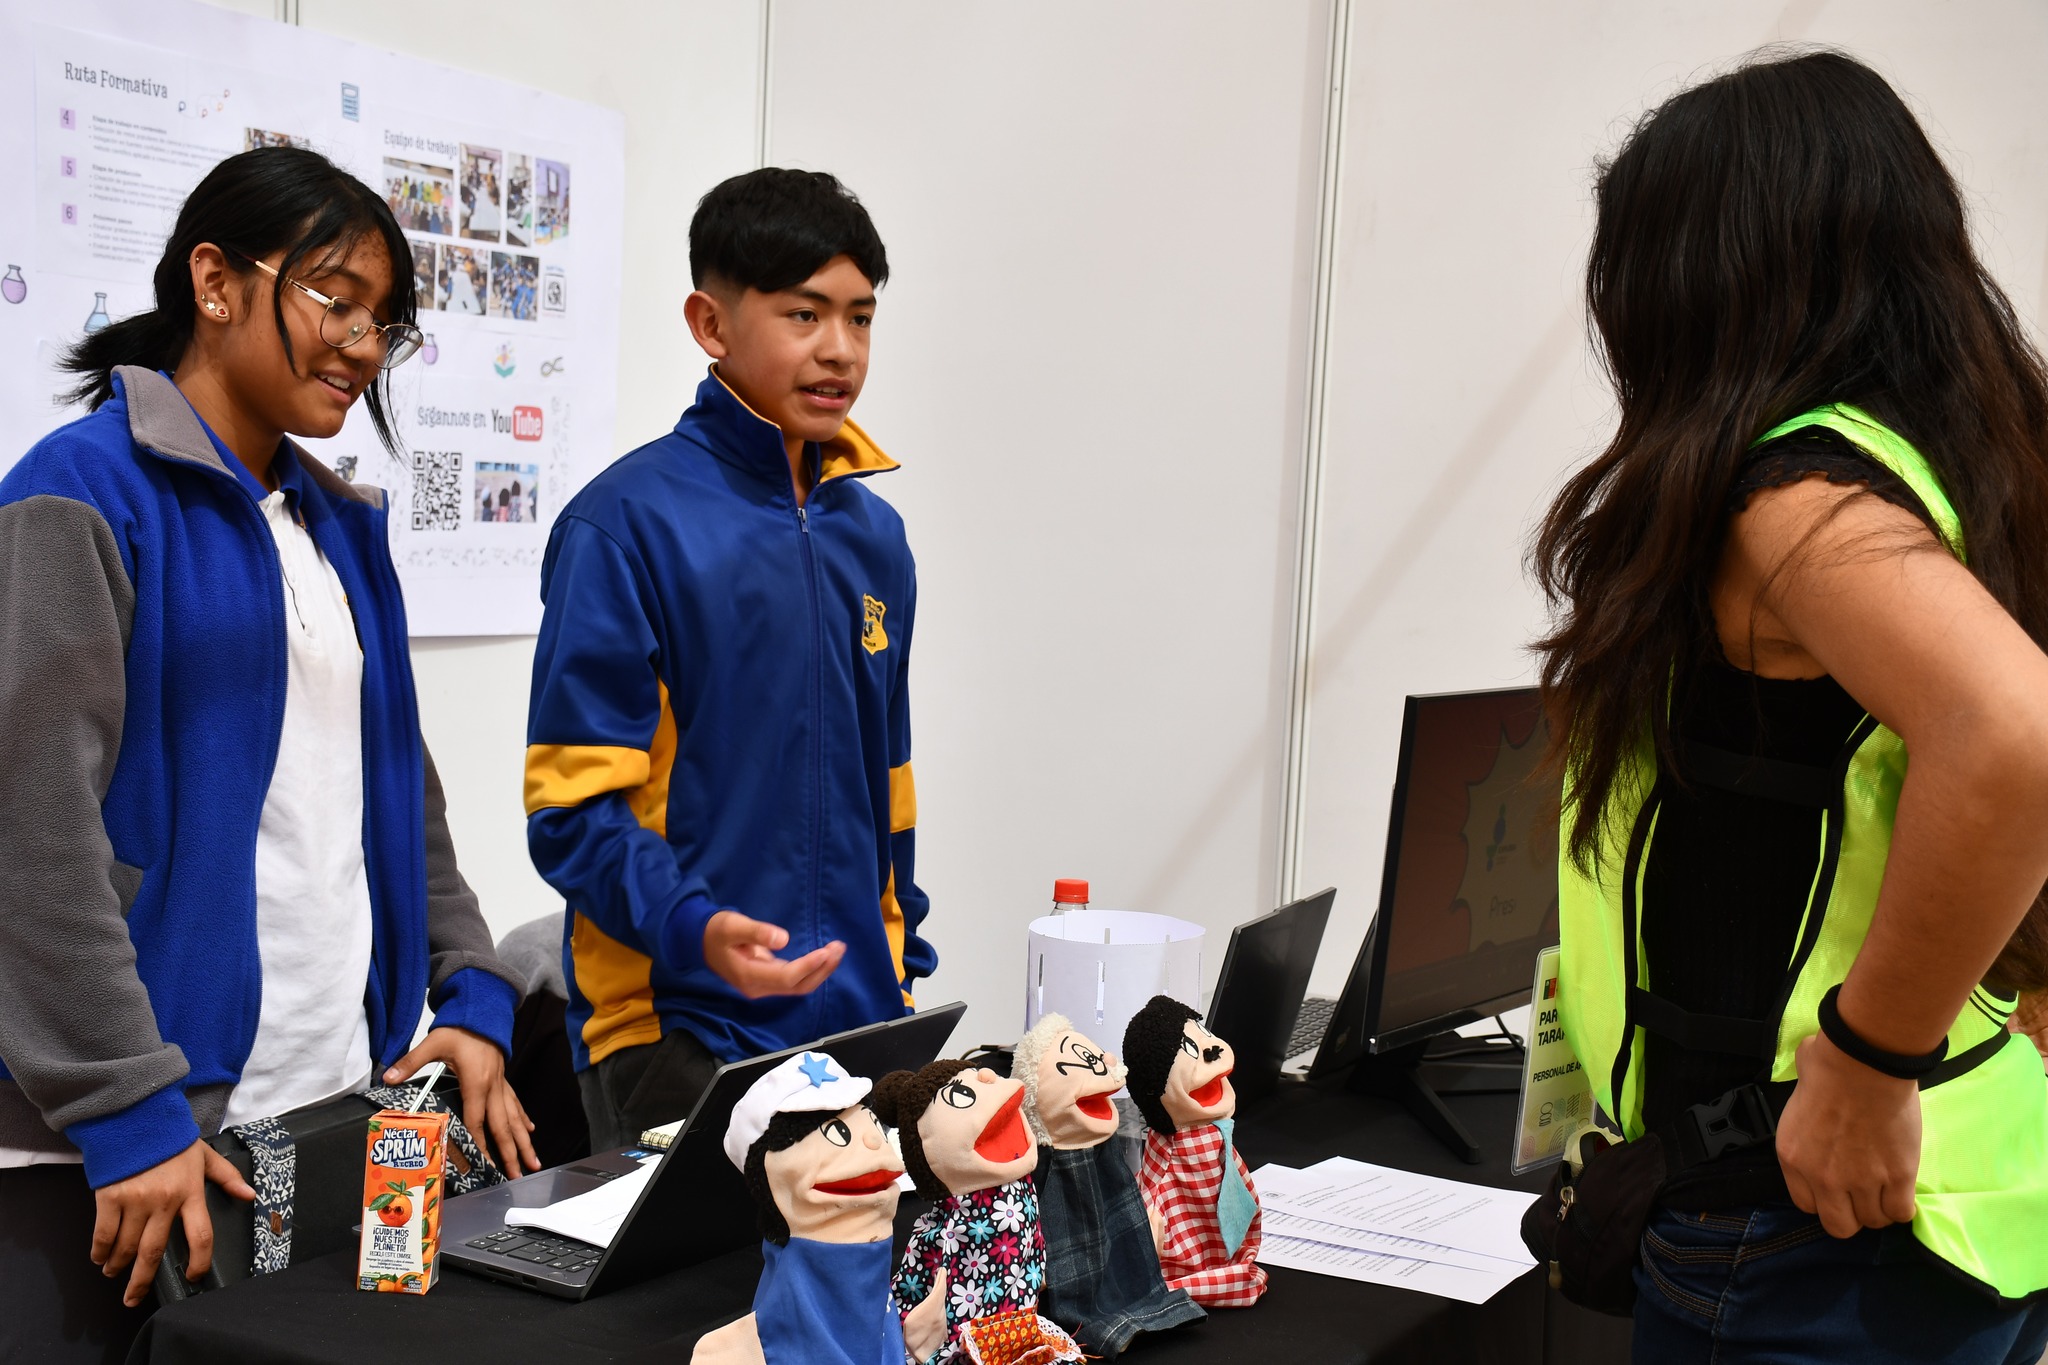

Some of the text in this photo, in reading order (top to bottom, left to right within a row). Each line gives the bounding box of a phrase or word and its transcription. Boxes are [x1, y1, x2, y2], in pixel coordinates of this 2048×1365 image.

[64, 61, 168, 99] Ruta Formativa
[62, 109, 70, 125] 4
[66, 160, 73, 175] 5
[65, 205, 73, 220] 6
[473, 412, 487, 428] en
[1539, 1008, 1558, 1026] PAR
[1532, 1065, 1566, 1083] PERSONAL
[1565, 1062, 1575, 1073] DE
[383, 1127, 418, 1139] Néctar
[373, 1137, 426, 1163] SPRIM
[393, 1160, 424, 1168] RECREO
[373, 1227, 409, 1238] ¡CUIDEMOS
[374, 1235, 407, 1245] NUESTRO
[373, 1243, 407, 1252] PLANETA!
